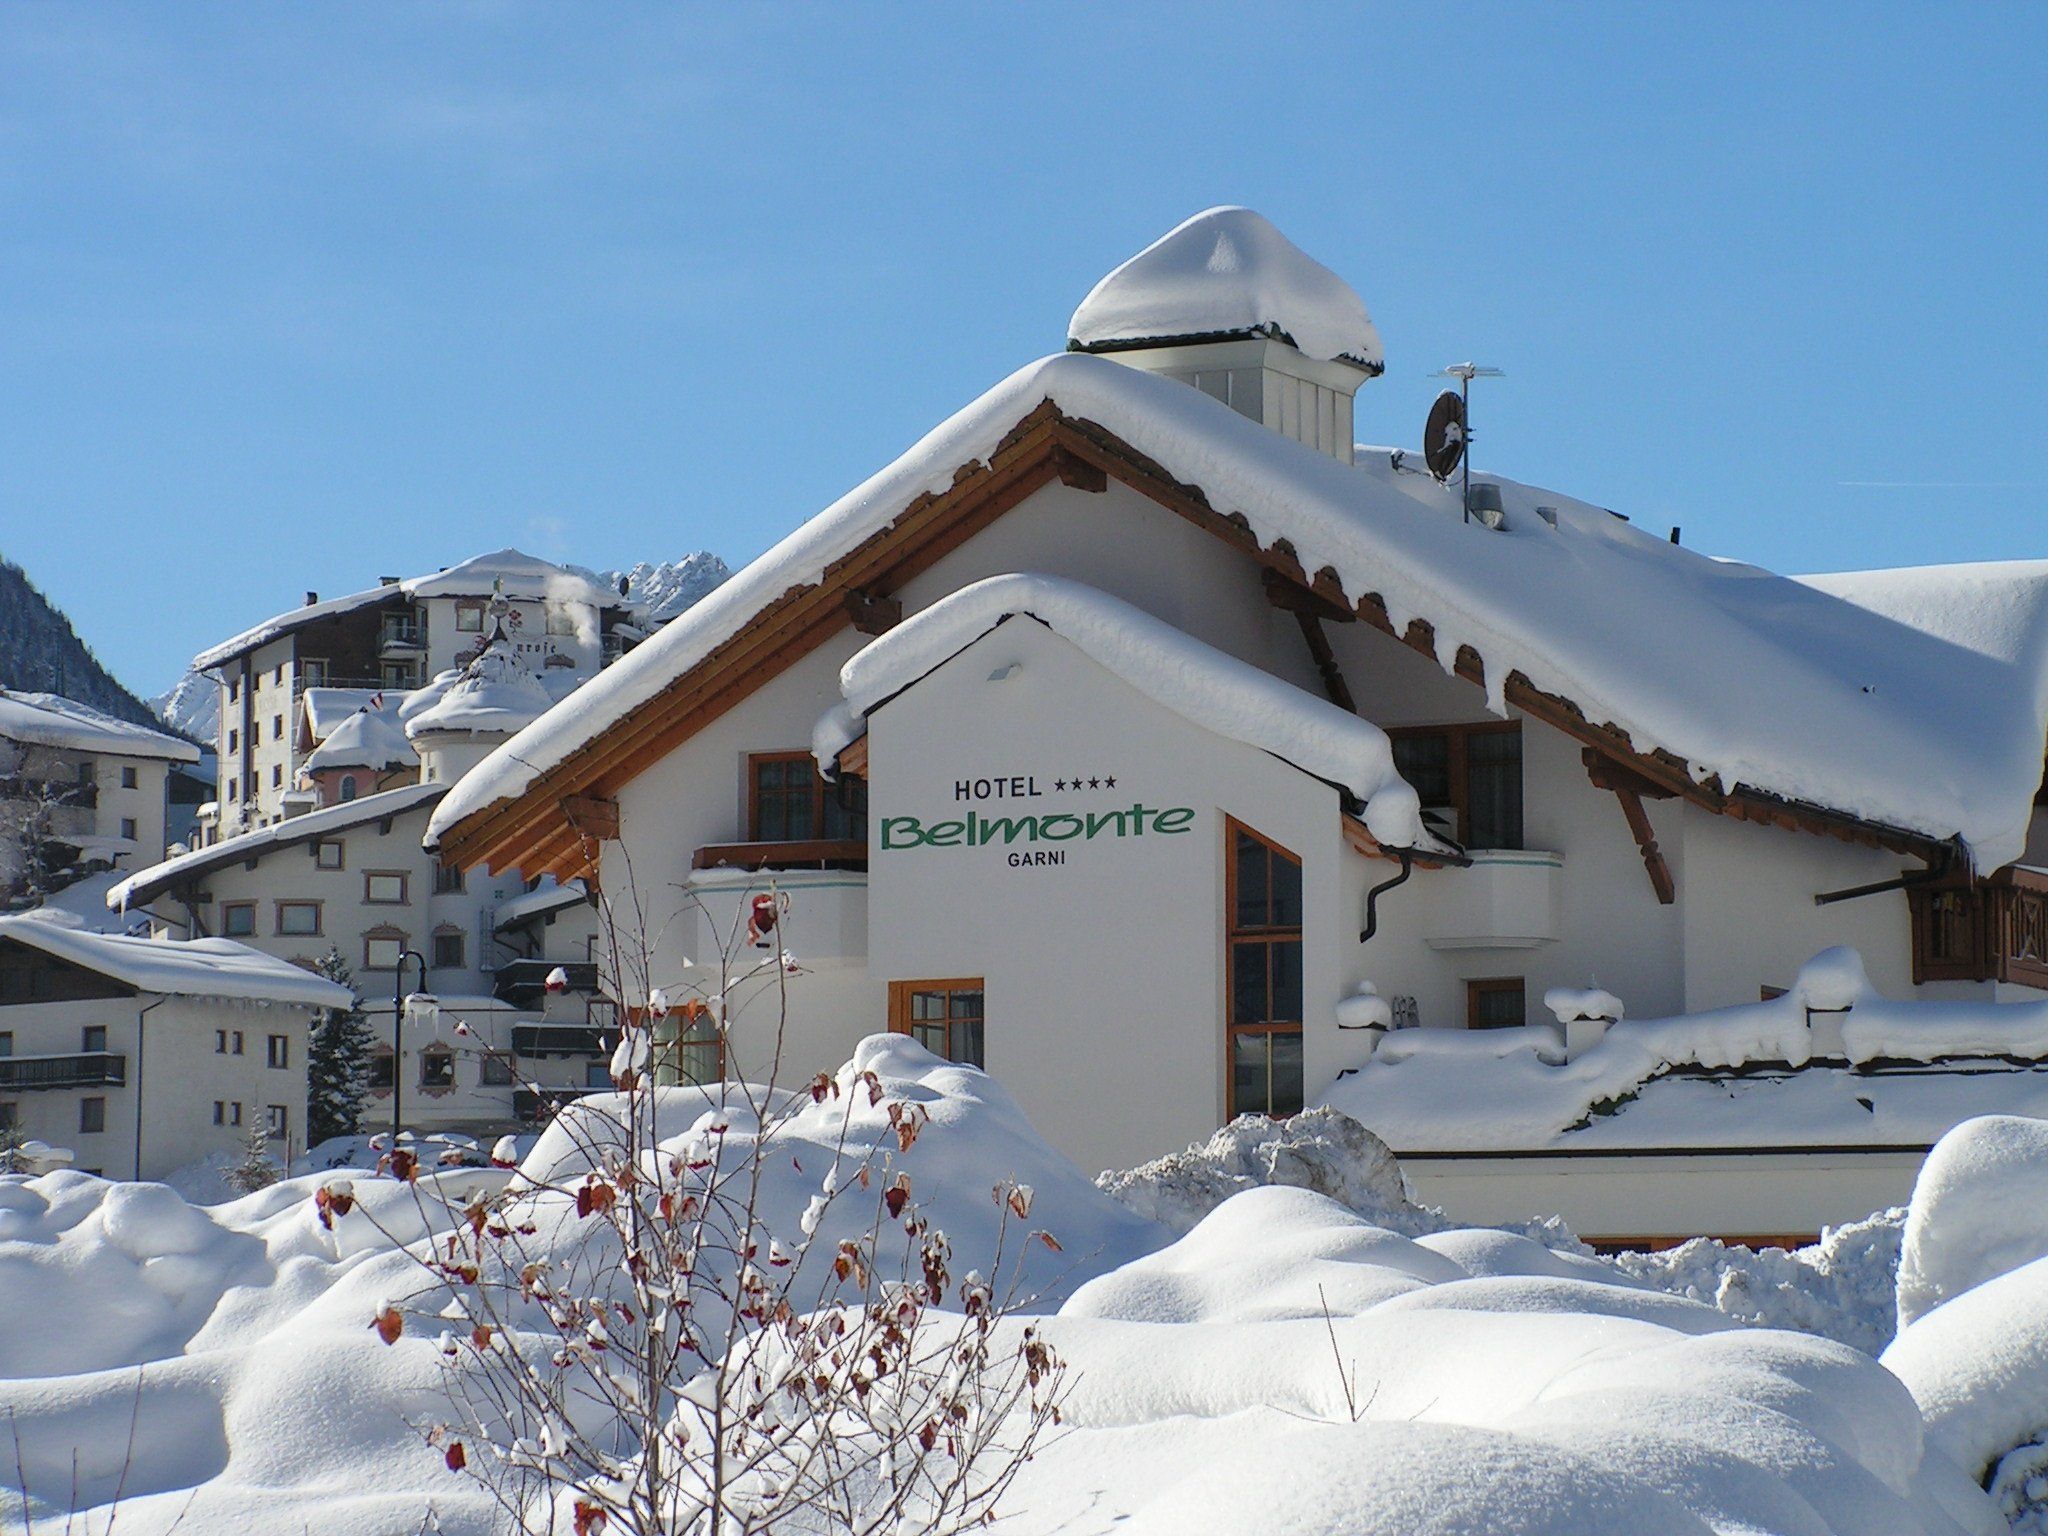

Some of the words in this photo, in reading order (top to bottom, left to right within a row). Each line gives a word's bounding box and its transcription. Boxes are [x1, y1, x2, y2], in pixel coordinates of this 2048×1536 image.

[955, 776, 1042, 801] HOTEL
[881, 803, 1195, 850] Belmonte
[1008, 850, 1065, 868] GARNI
